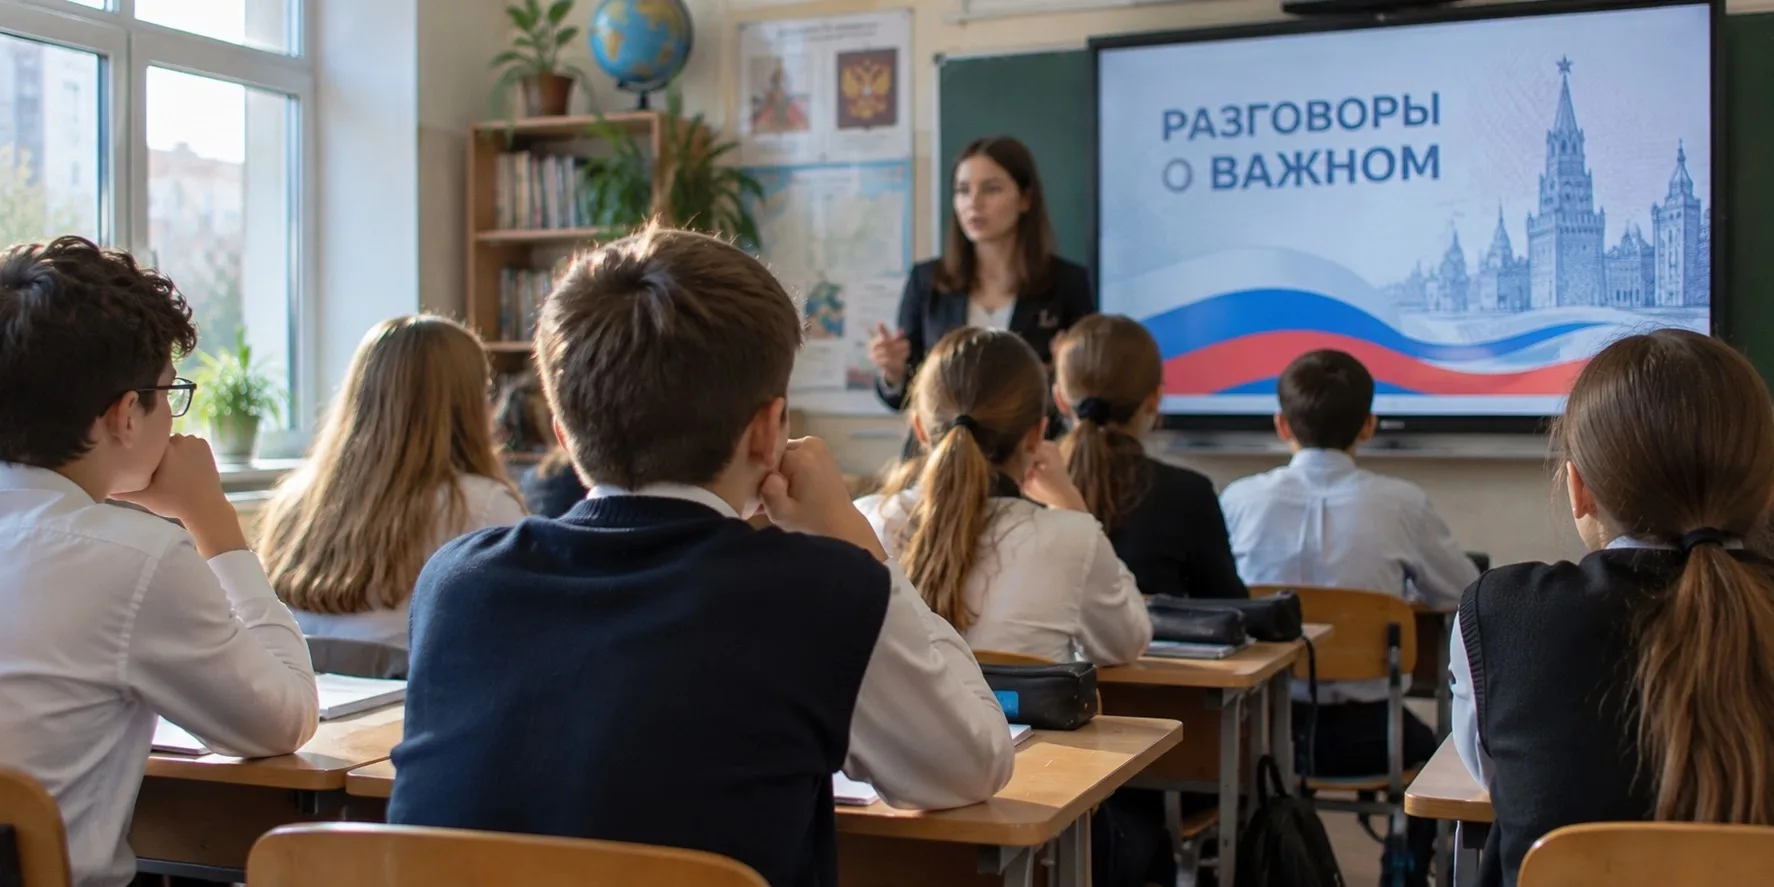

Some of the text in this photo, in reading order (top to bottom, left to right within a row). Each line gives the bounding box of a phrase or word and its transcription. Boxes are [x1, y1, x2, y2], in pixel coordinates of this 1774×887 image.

[1162, 92, 1440, 141] РАЗГОВОРЫ
[1162, 144, 1440, 194] О ВАЖНОМ
